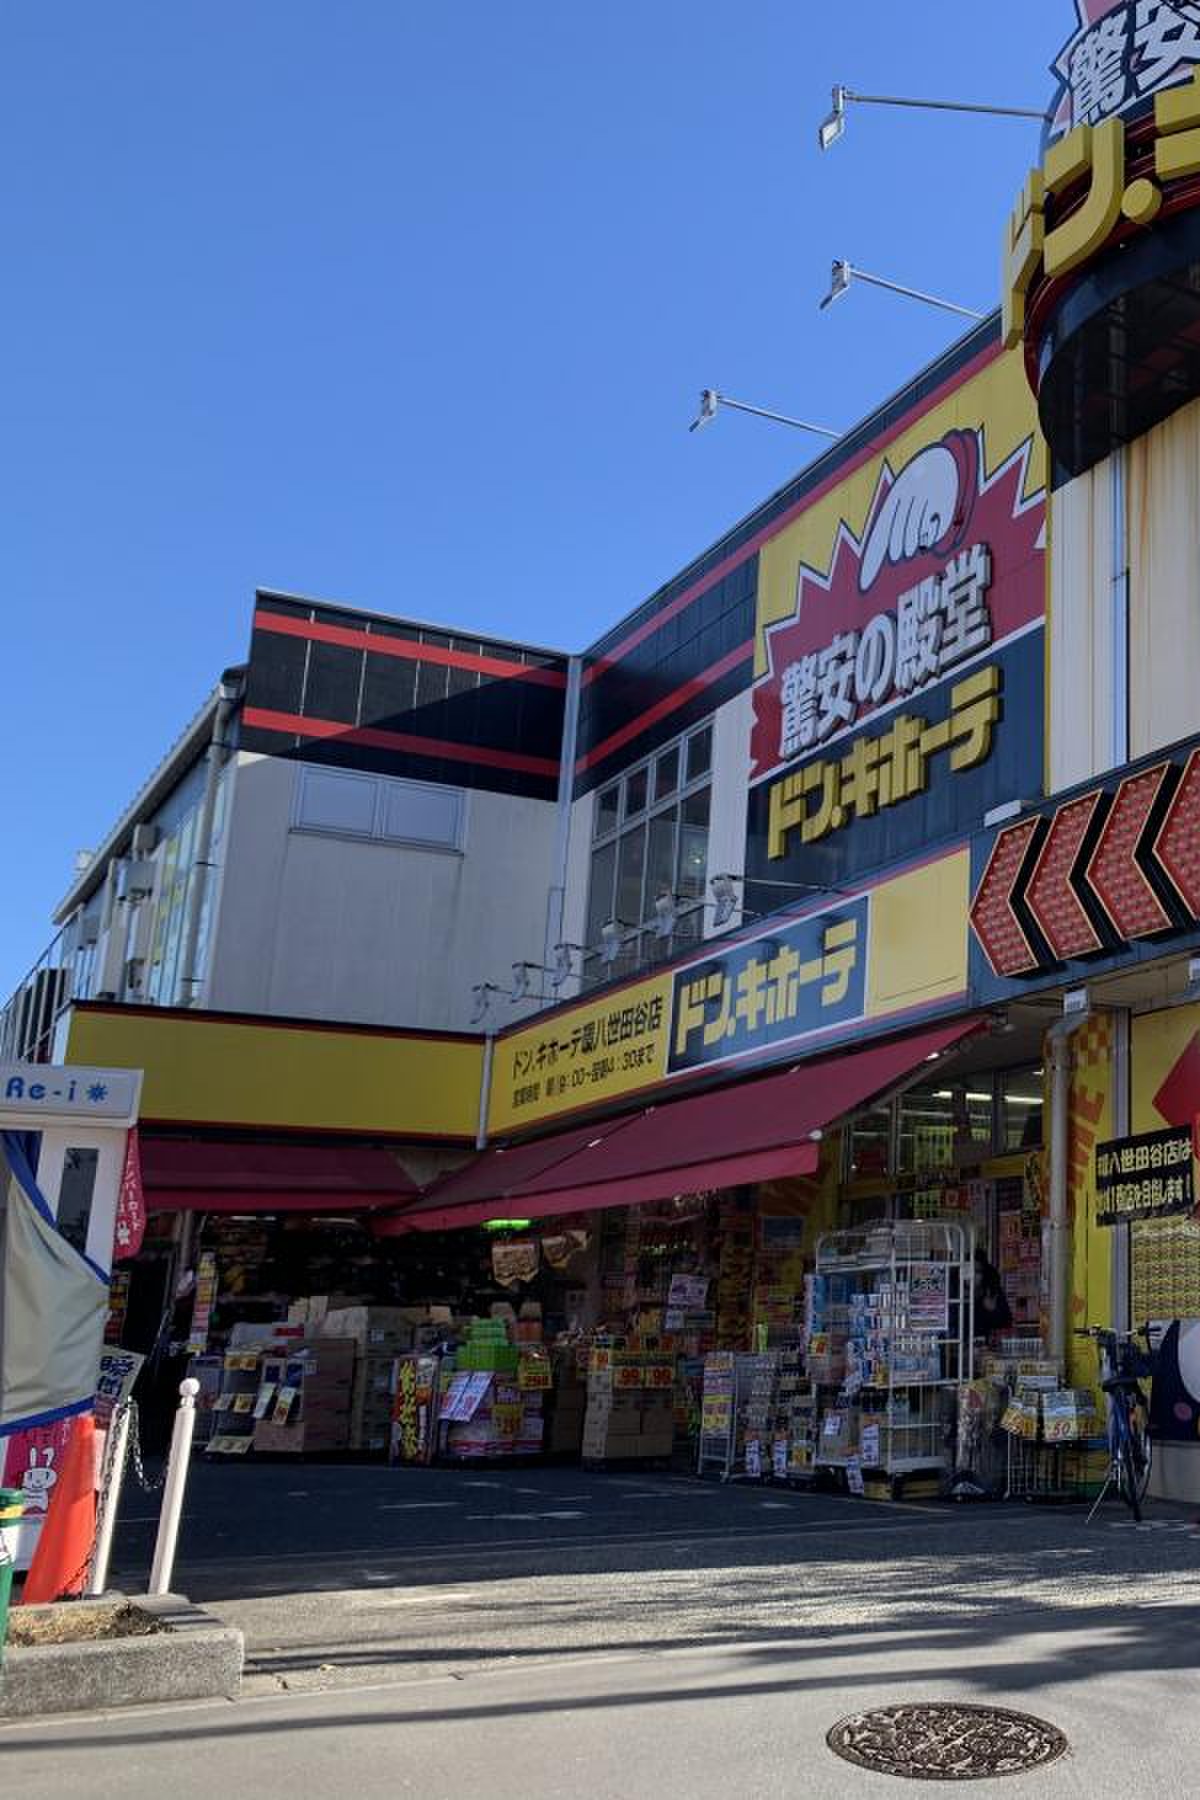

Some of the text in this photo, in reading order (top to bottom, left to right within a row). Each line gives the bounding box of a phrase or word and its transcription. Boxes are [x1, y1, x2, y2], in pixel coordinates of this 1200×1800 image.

[781, 544, 991, 759] 驚安の殿堂
